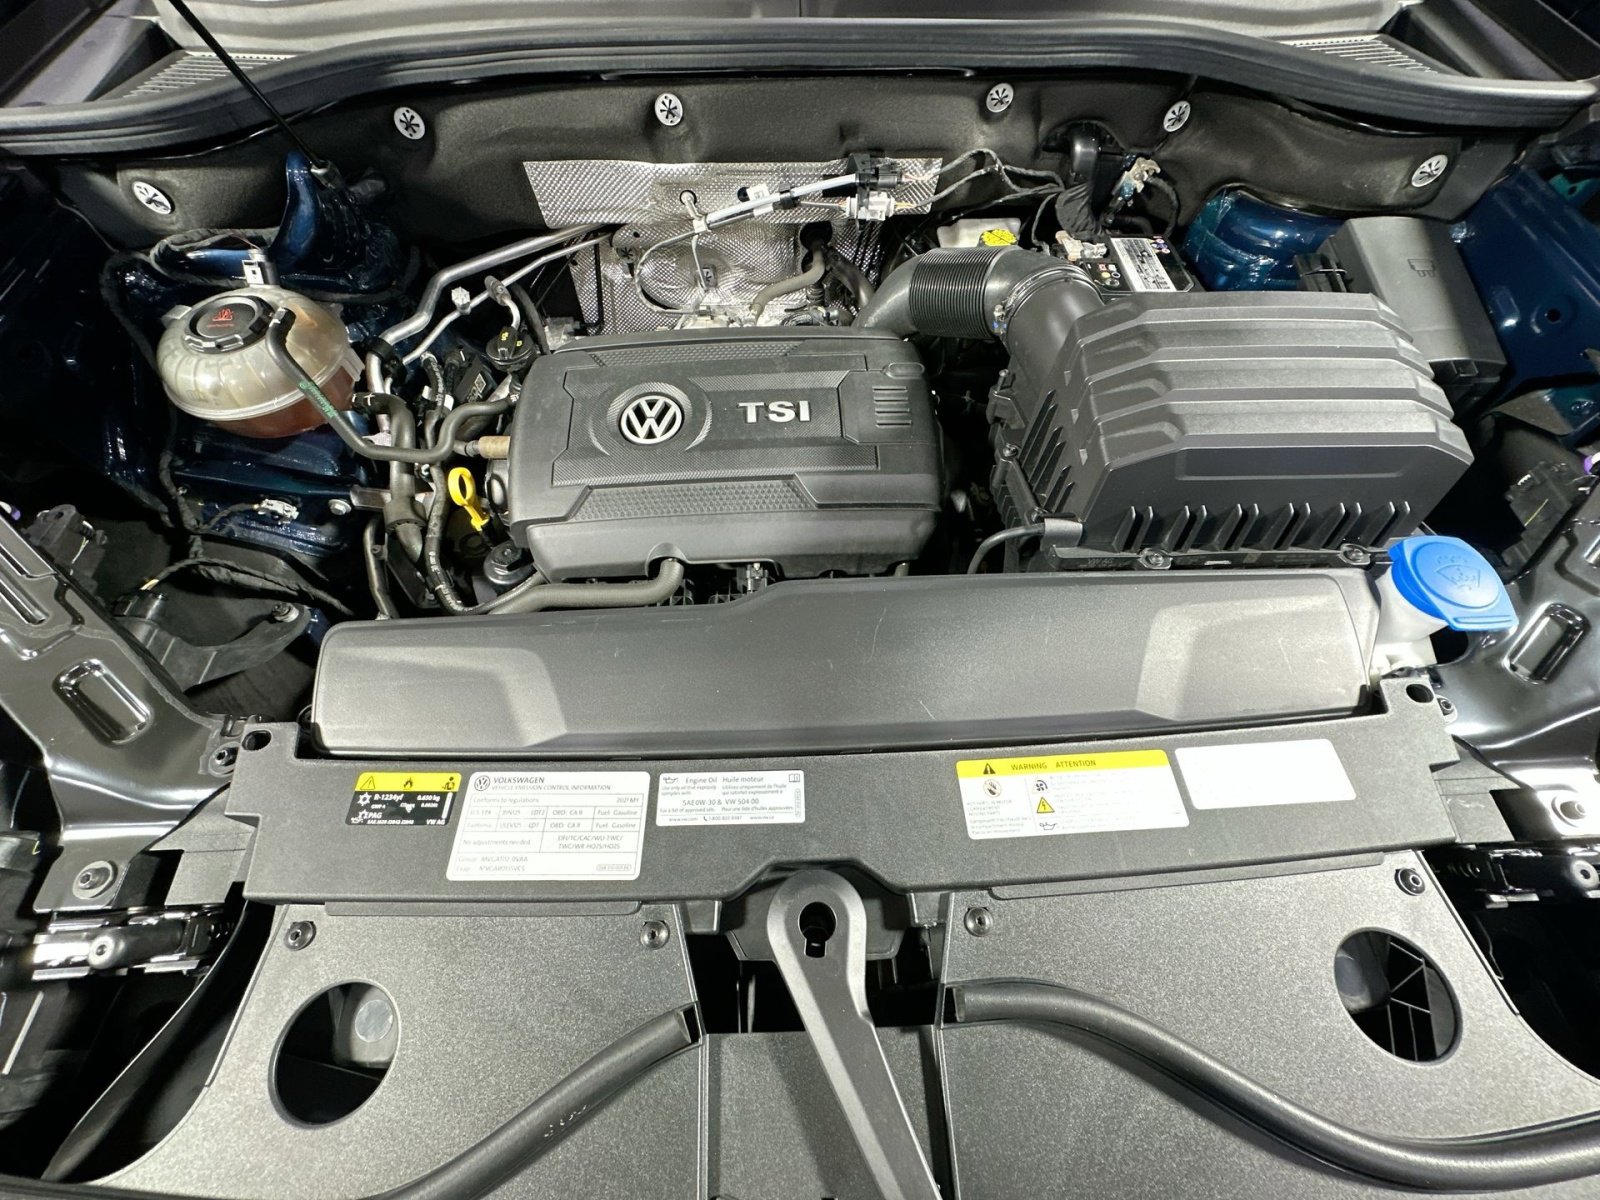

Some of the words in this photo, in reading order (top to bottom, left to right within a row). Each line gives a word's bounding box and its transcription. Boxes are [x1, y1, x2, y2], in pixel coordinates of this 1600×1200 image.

[738, 400, 810, 423] TSI
[1010, 762, 1048, 771] WARNING
[1055, 759, 1096, 768] ATTENTION
[493, 776, 545, 784] VOLKSWAGEN
[685, 777, 707, 785] Engine
[374, 794, 404, 802] R-1234yf
[433, 794, 440, 802] kg
[508, 796, 539, 804] regulations
[612, 822, 636, 830] Gasoline
